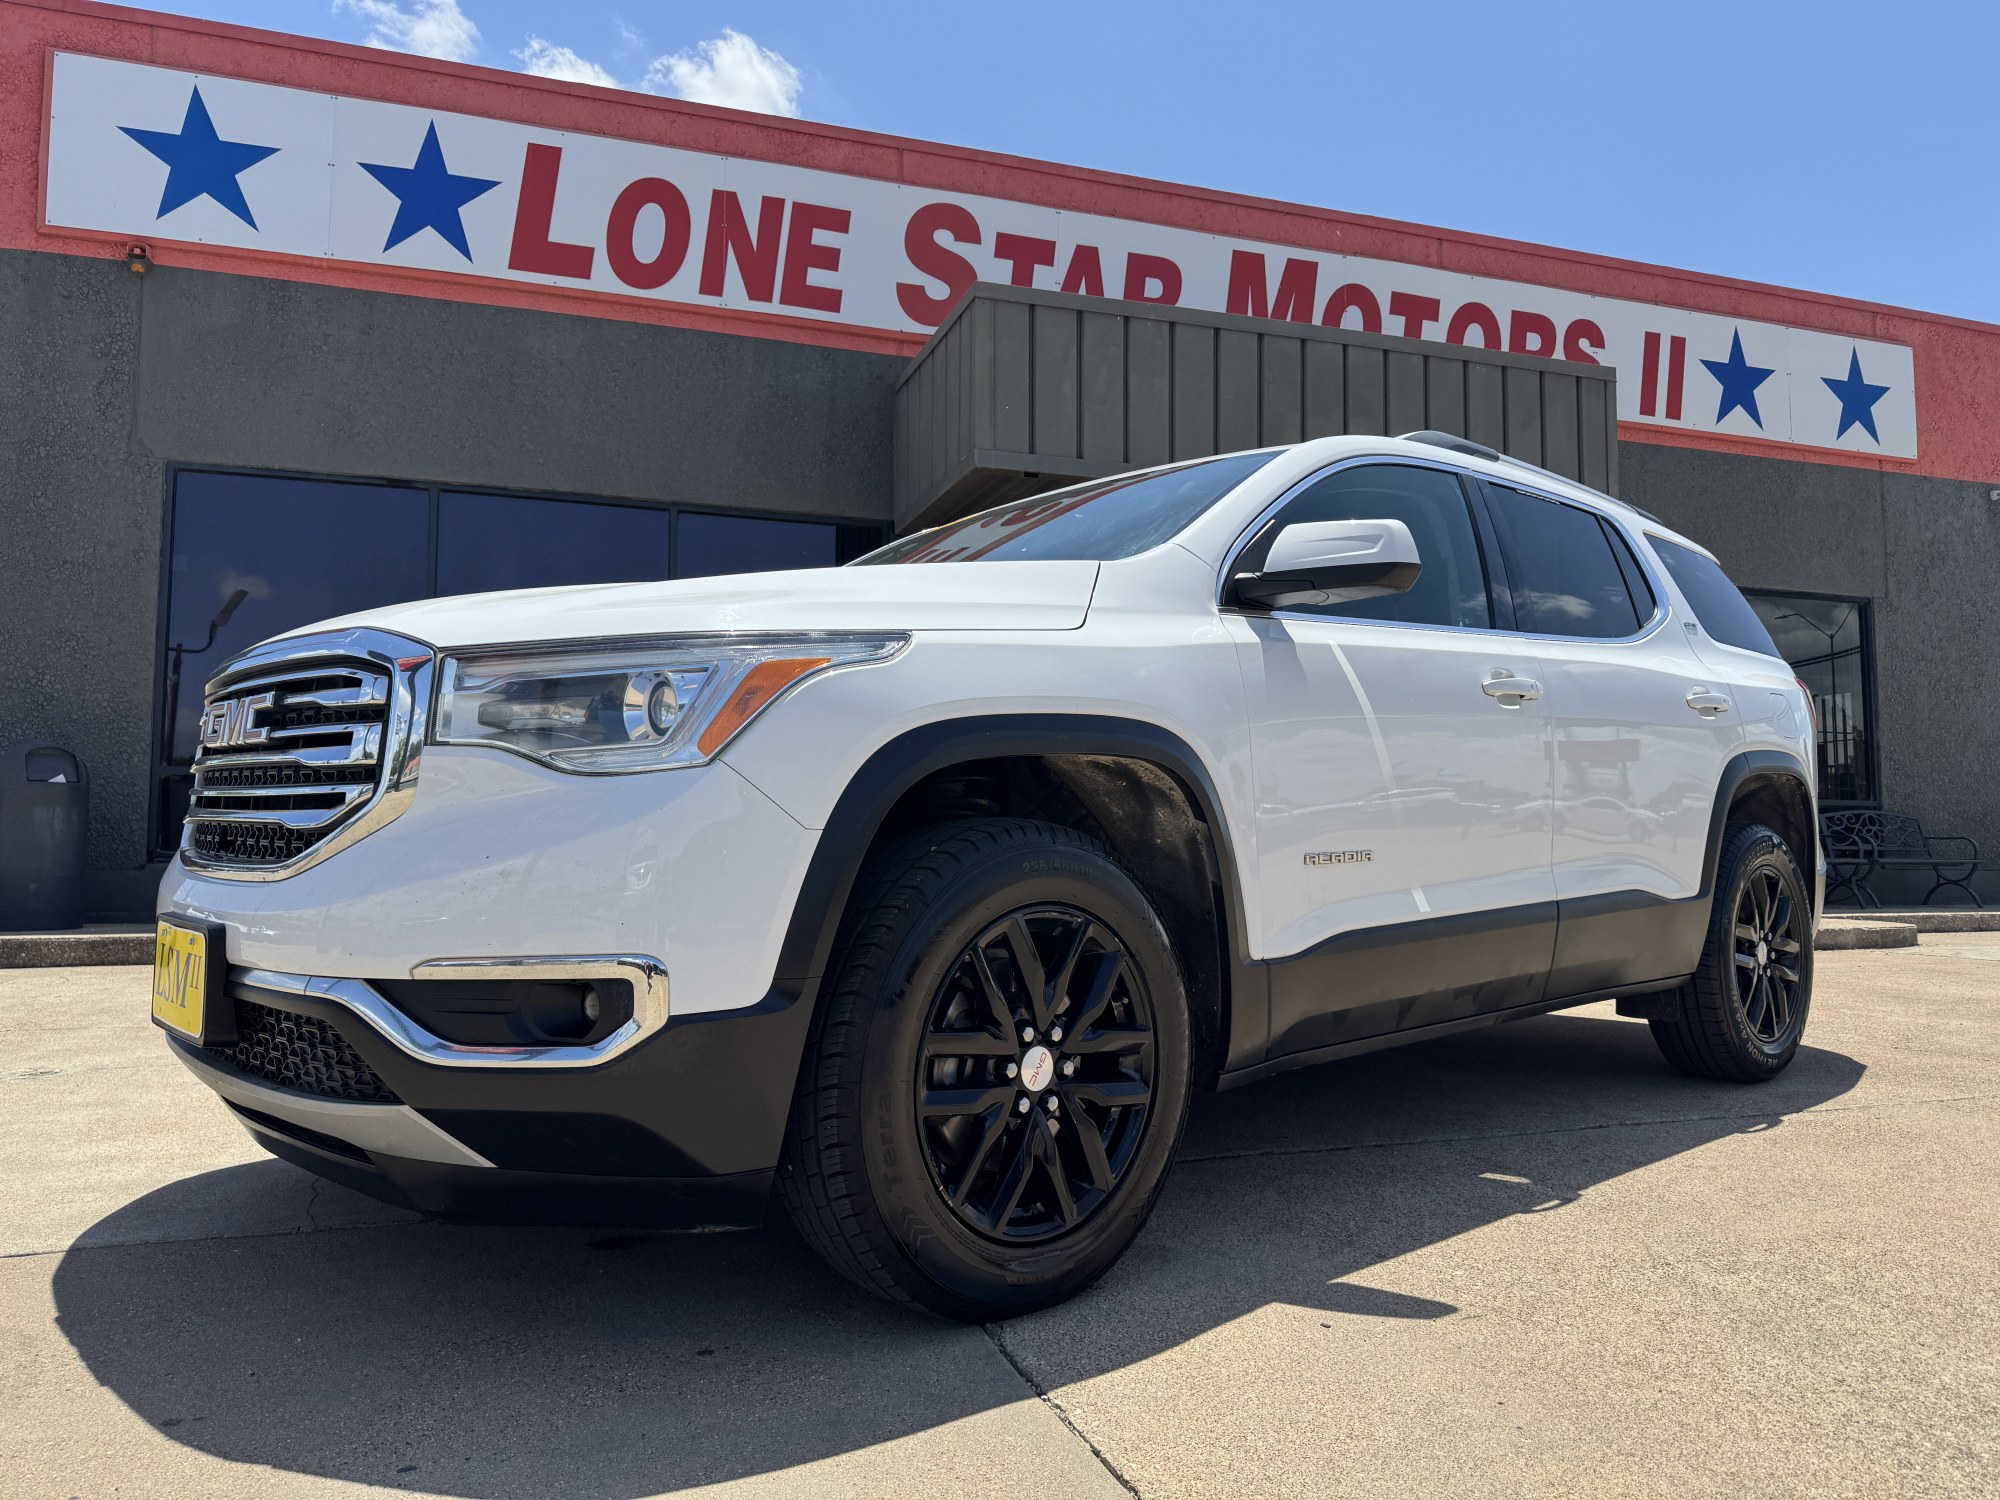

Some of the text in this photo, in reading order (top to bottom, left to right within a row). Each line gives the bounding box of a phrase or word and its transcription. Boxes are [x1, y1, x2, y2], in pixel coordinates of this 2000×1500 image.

[1639, 331, 1687, 421] II
[204, 691, 275, 746] GMC
[1303, 850, 1374, 865] ACADIA
[1028, 1052, 1047, 1087] GMC
